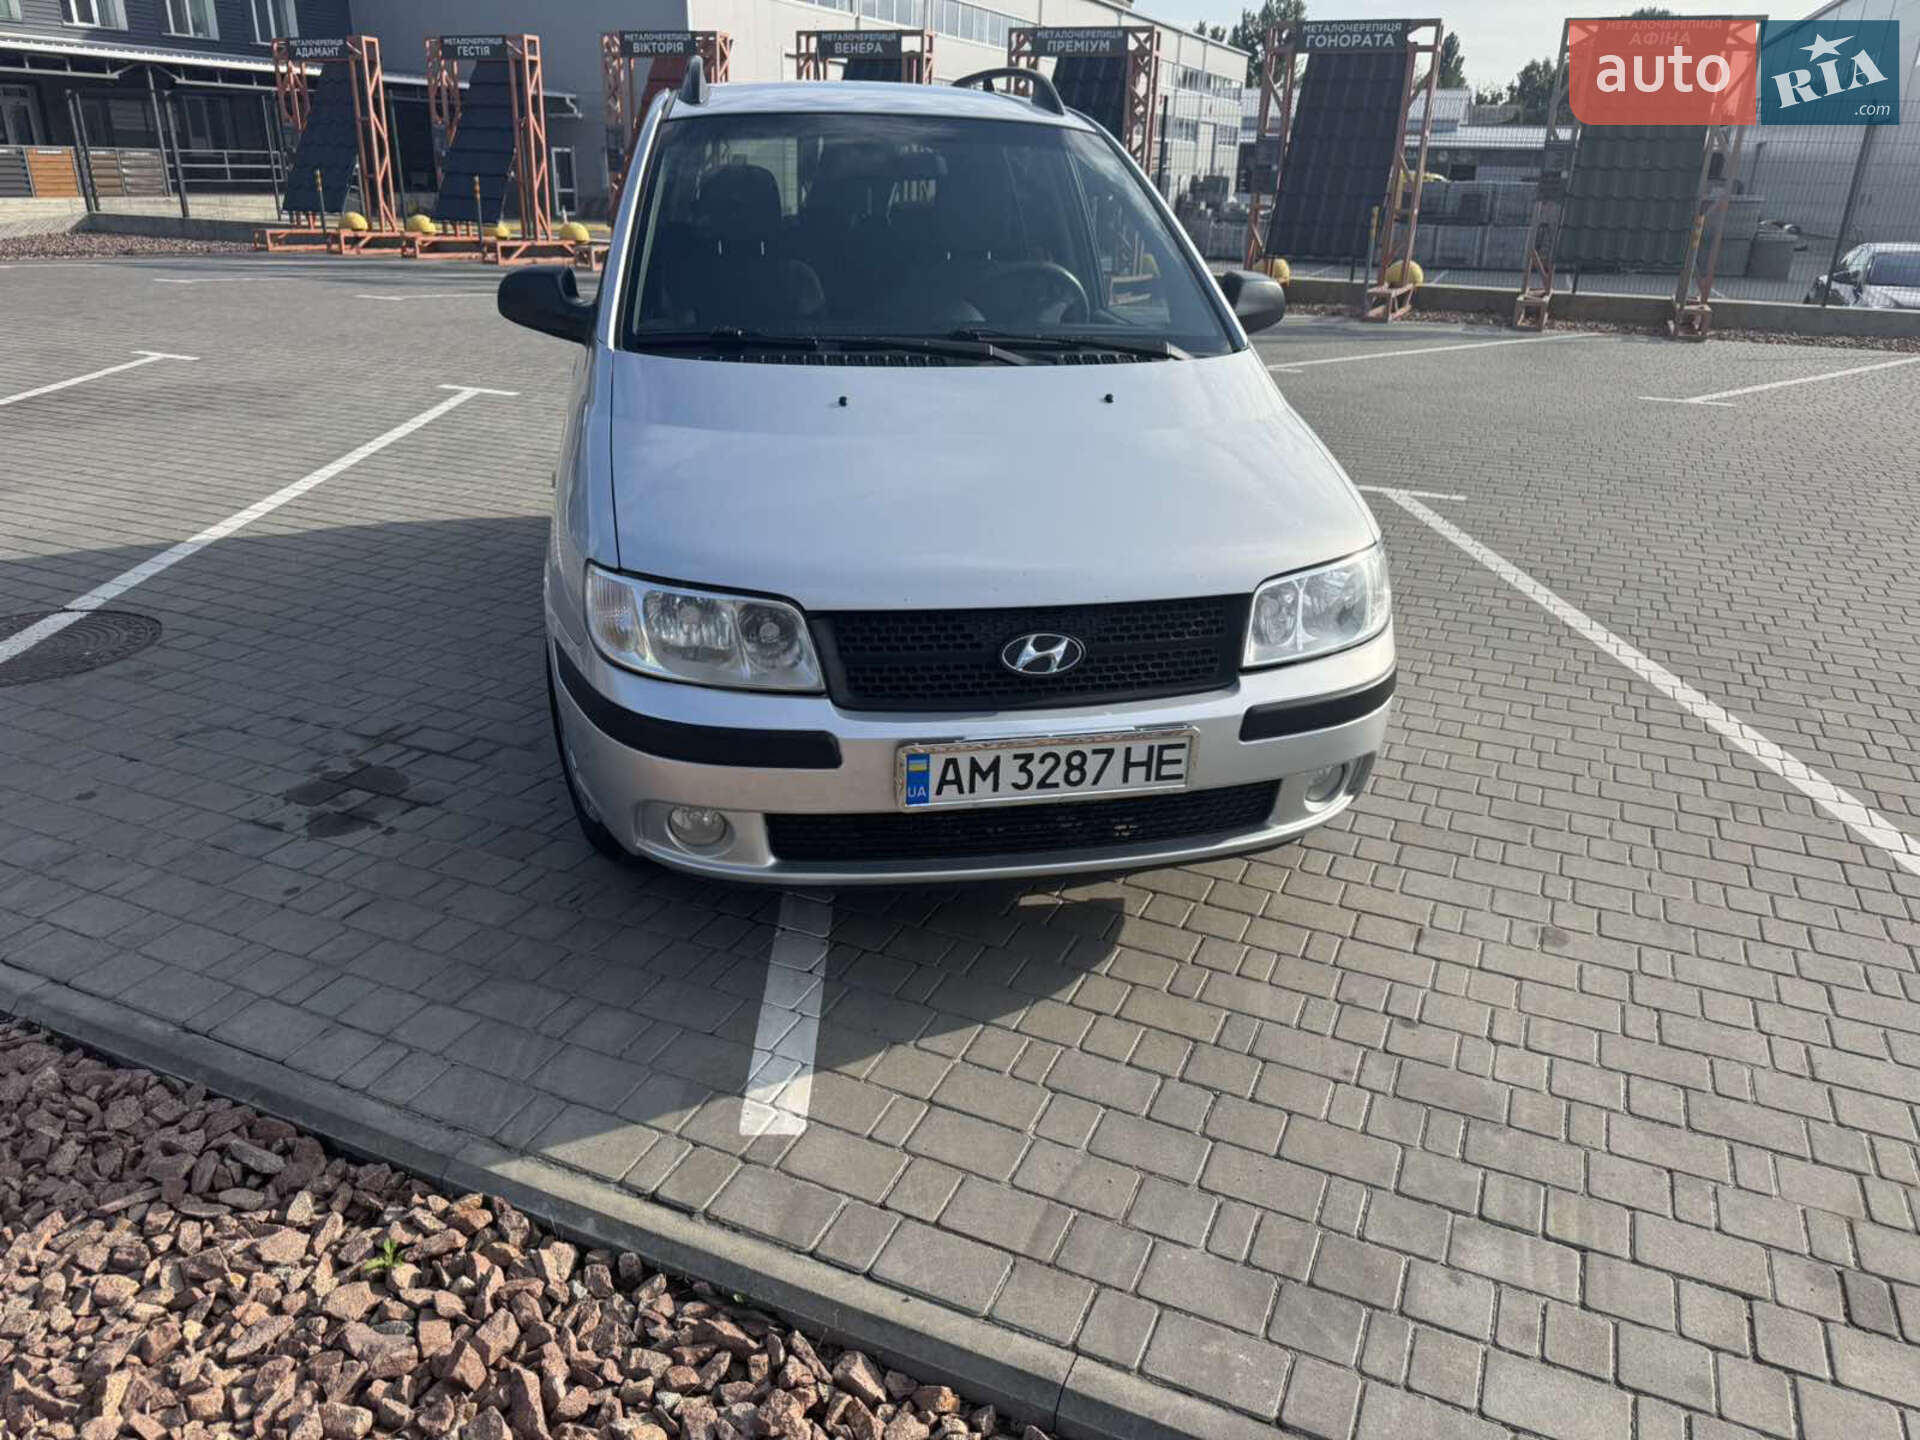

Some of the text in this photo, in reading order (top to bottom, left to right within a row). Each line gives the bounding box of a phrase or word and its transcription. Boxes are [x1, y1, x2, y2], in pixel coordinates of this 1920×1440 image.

[1303, 22, 1402, 33] МЕТАЛОЧЕРЕПИЦЯ
[1305, 33, 1395, 48] ГОНОРАТА
[1628, 31, 1692, 46] АФІНА
[295, 47, 339, 57] АДАМАНТ
[457, 46, 491, 56] ГЕСТІЯ
[633, 42, 684, 53] ВІКТОРІЯ
[834, 42, 884, 54] ВЕНЕРА
[1047, 40, 1110, 52] ПРЕМІУМ
[935, 742, 1187, 796] AM 3287 HE
[907, 785, 927, 798] UA
